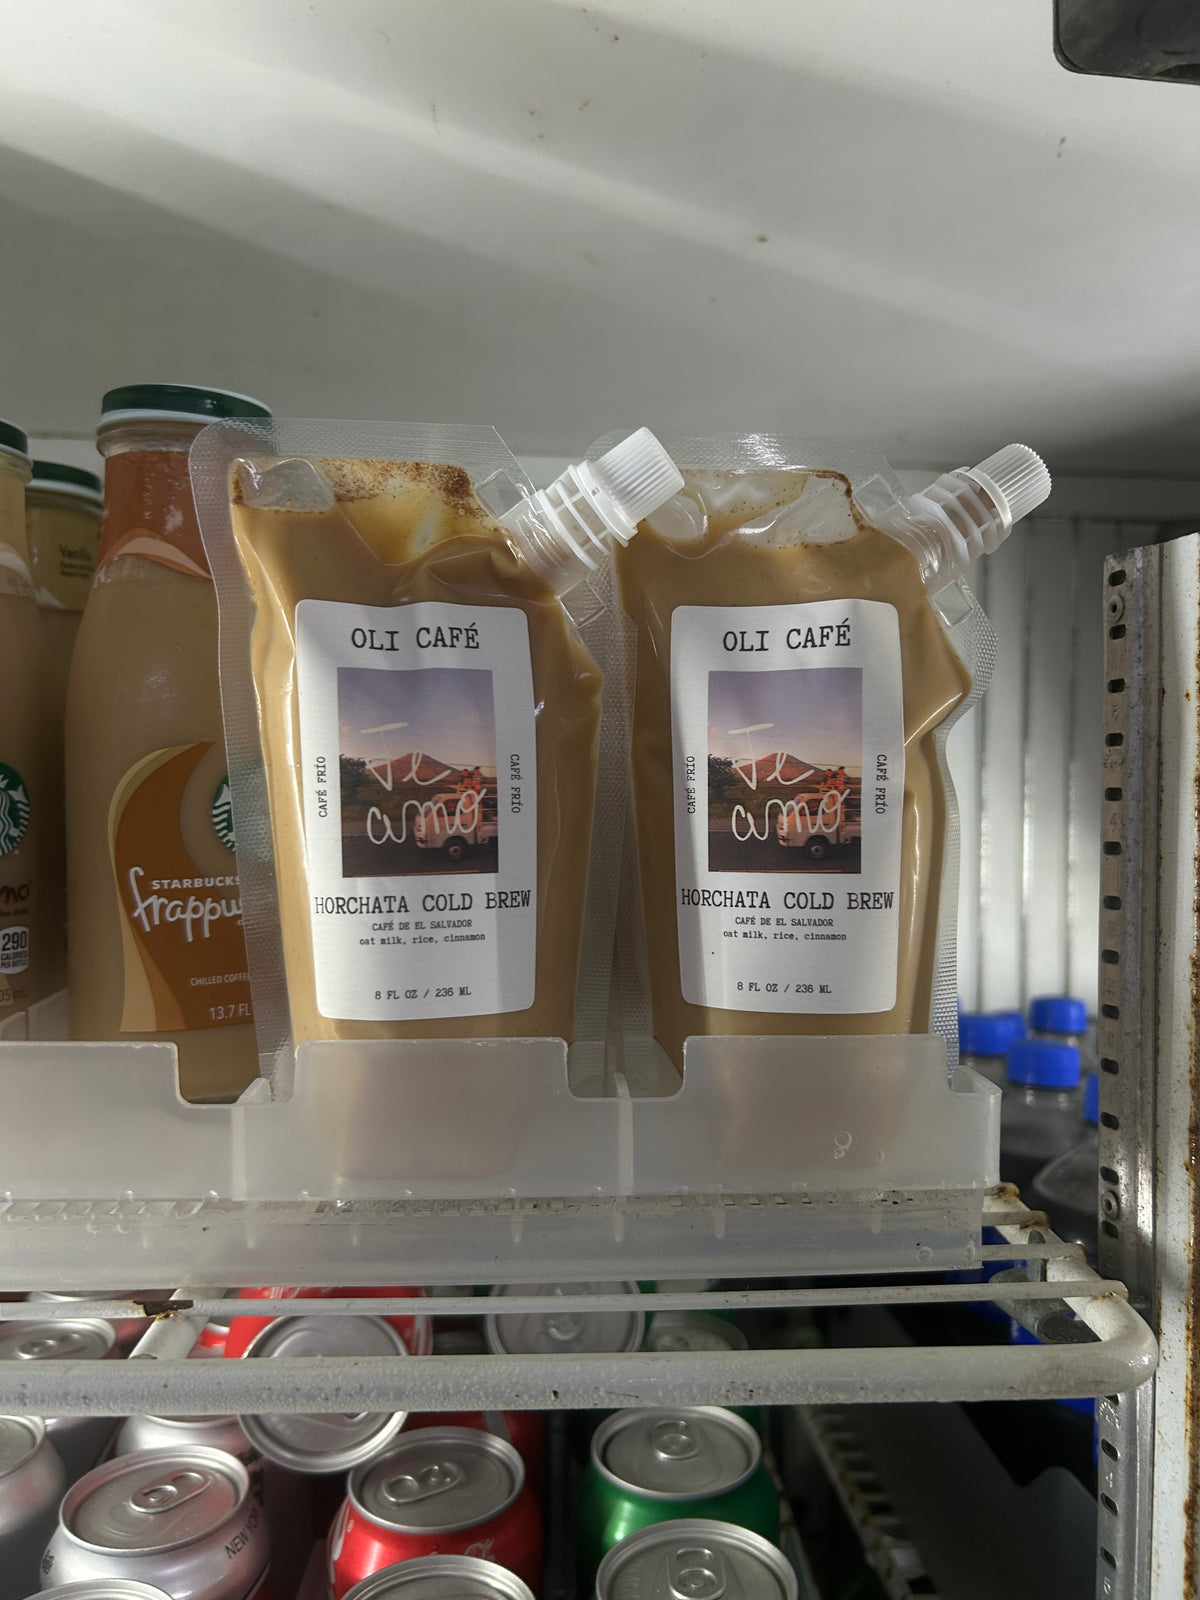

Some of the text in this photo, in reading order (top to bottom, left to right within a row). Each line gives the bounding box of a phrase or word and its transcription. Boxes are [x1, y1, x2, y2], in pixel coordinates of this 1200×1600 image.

[351, 621, 480, 652] OLI CAFÉ
[722, 617, 851, 652] OLI CAFÉ
[315, 756, 328, 818] CAFÉ FRÍO
[510, 753, 523, 814] CAFÉ FRÍO
[686, 755, 696, 814] CAFÉ FRÍO
[875, 753, 888, 815] CAFÉ FRÍO
[315, 890, 532, 914] HORCHATA COLD BREW
[681, 888, 894, 910] HORCHATA COLD BREW
[372, 919, 473, 931] CAFÉ DE EL SALVADOR
[735, 915, 834, 927] CAFÉ DE EL SALVADOR
[2, 931, 27, 951] 290
[359, 933, 486, 946] oat milk, rice, cinnamon
[723, 930, 847, 941] oat milk, rice, cinnamon
[190, 976, 223, 986] CHILLED
[737, 982, 744, 992] 8
[748, 982, 761, 992] FL
[765, 983, 778, 993] OZ
[784, 983, 790, 993] /
[819, 985, 832, 995] ML
[375, 991, 382, 1000] 8
[387, 990, 400, 1000] FL
[405, 989, 418, 999] OZ
[423, 988, 430, 998] /
[459, 986, 472, 996] ML
[209, 1002, 251, 1020] 13.7 FL
[225, 1527, 249, 1559] NEW
